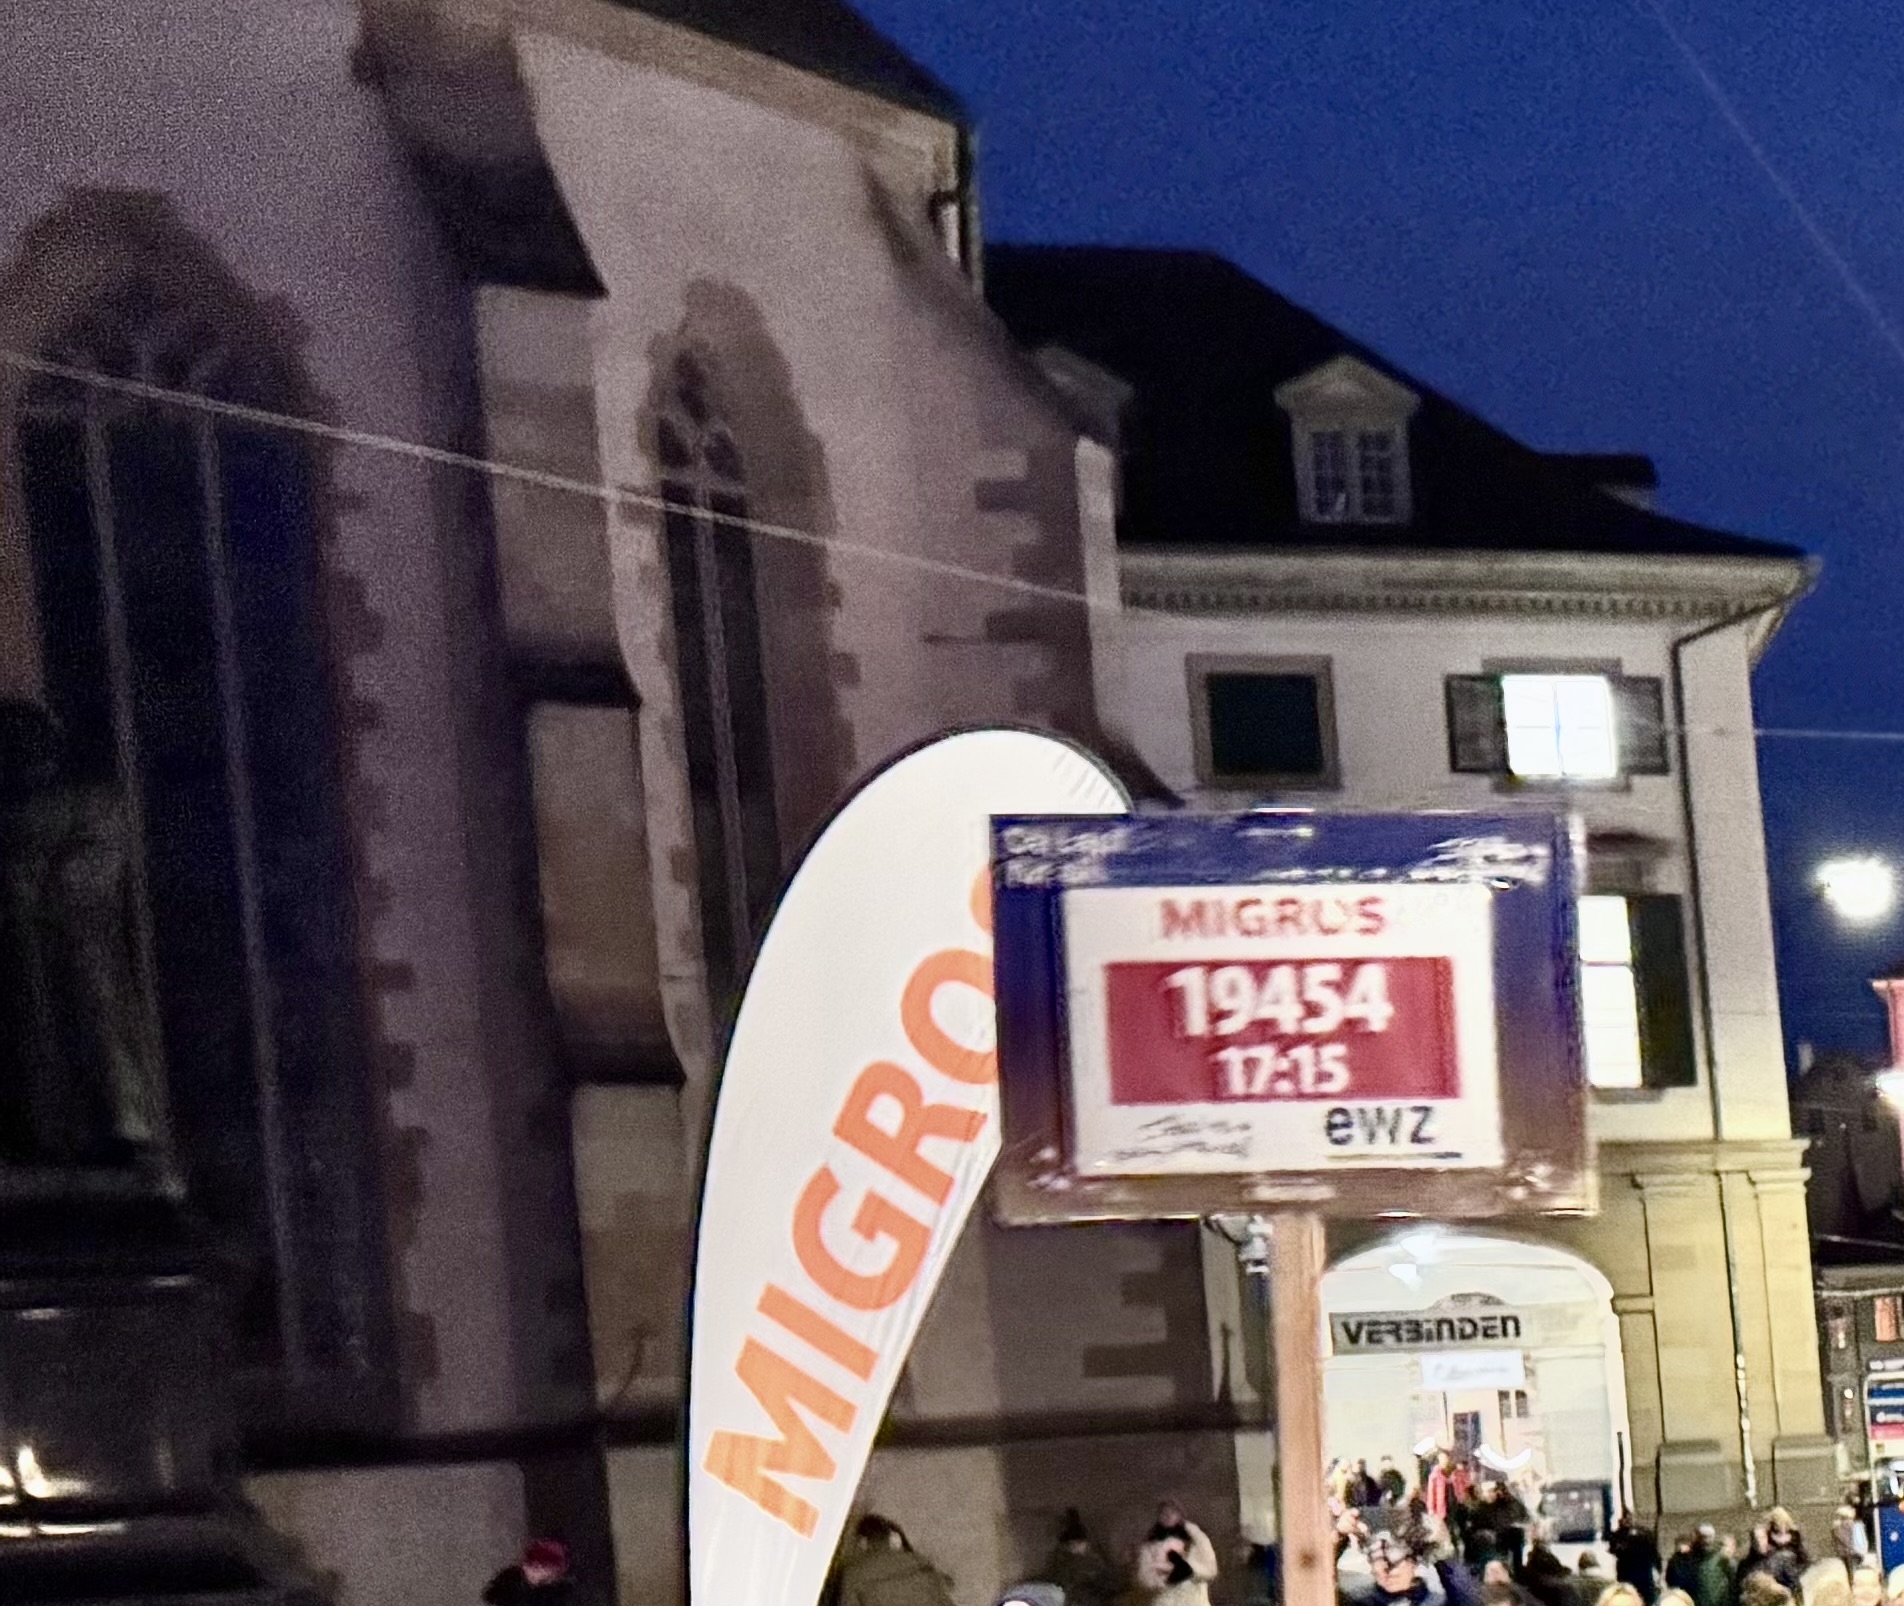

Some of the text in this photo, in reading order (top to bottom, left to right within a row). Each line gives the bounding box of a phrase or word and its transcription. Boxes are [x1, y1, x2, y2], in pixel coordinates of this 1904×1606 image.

[1160, 896, 1386, 938] MIGROS
[1164, 963, 1395, 1037] 19454
[1211, 1043, 1351, 1095] 17:15
[1325, 1105, 1437, 1146] ewz
[703, 866, 998, 1540] MIGRO
